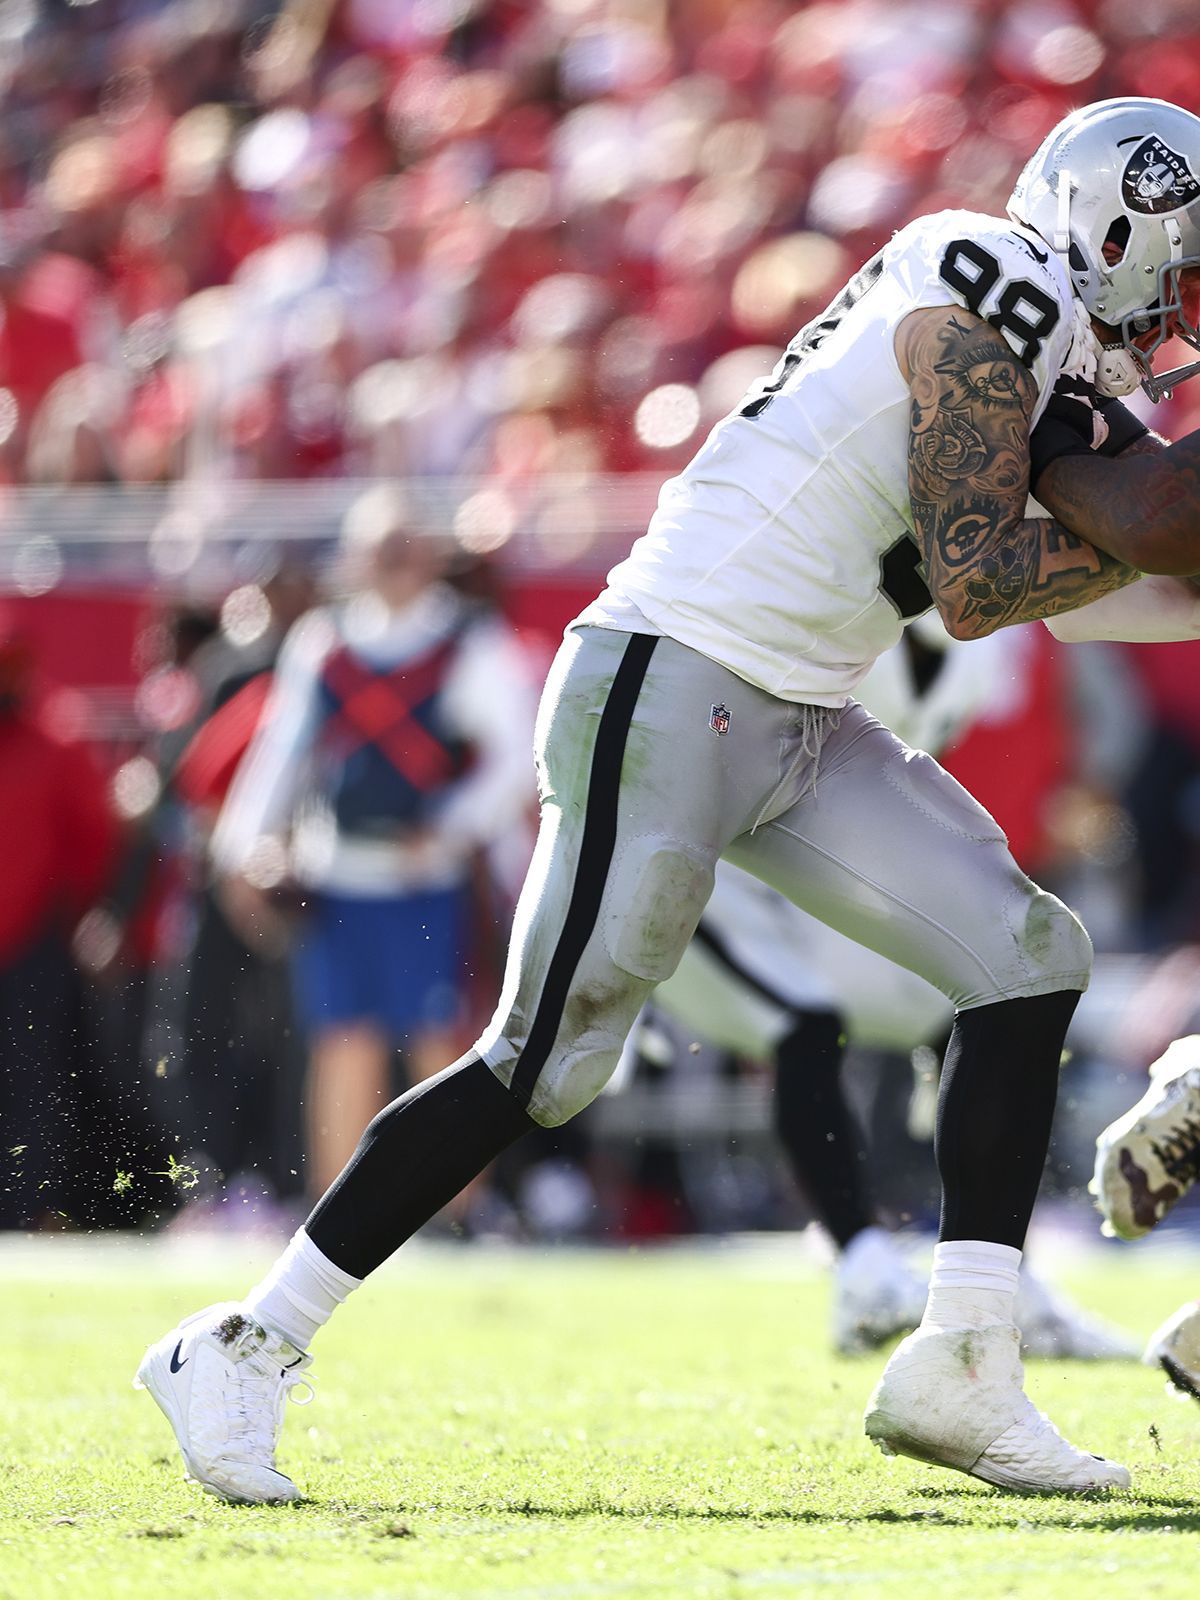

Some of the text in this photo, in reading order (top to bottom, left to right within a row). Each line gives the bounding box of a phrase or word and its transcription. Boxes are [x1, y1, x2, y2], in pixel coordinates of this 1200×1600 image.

[1152, 141, 1198, 191] RAIDERS
[938, 238, 1063, 369] 98
[712, 716, 729, 732] NFL
